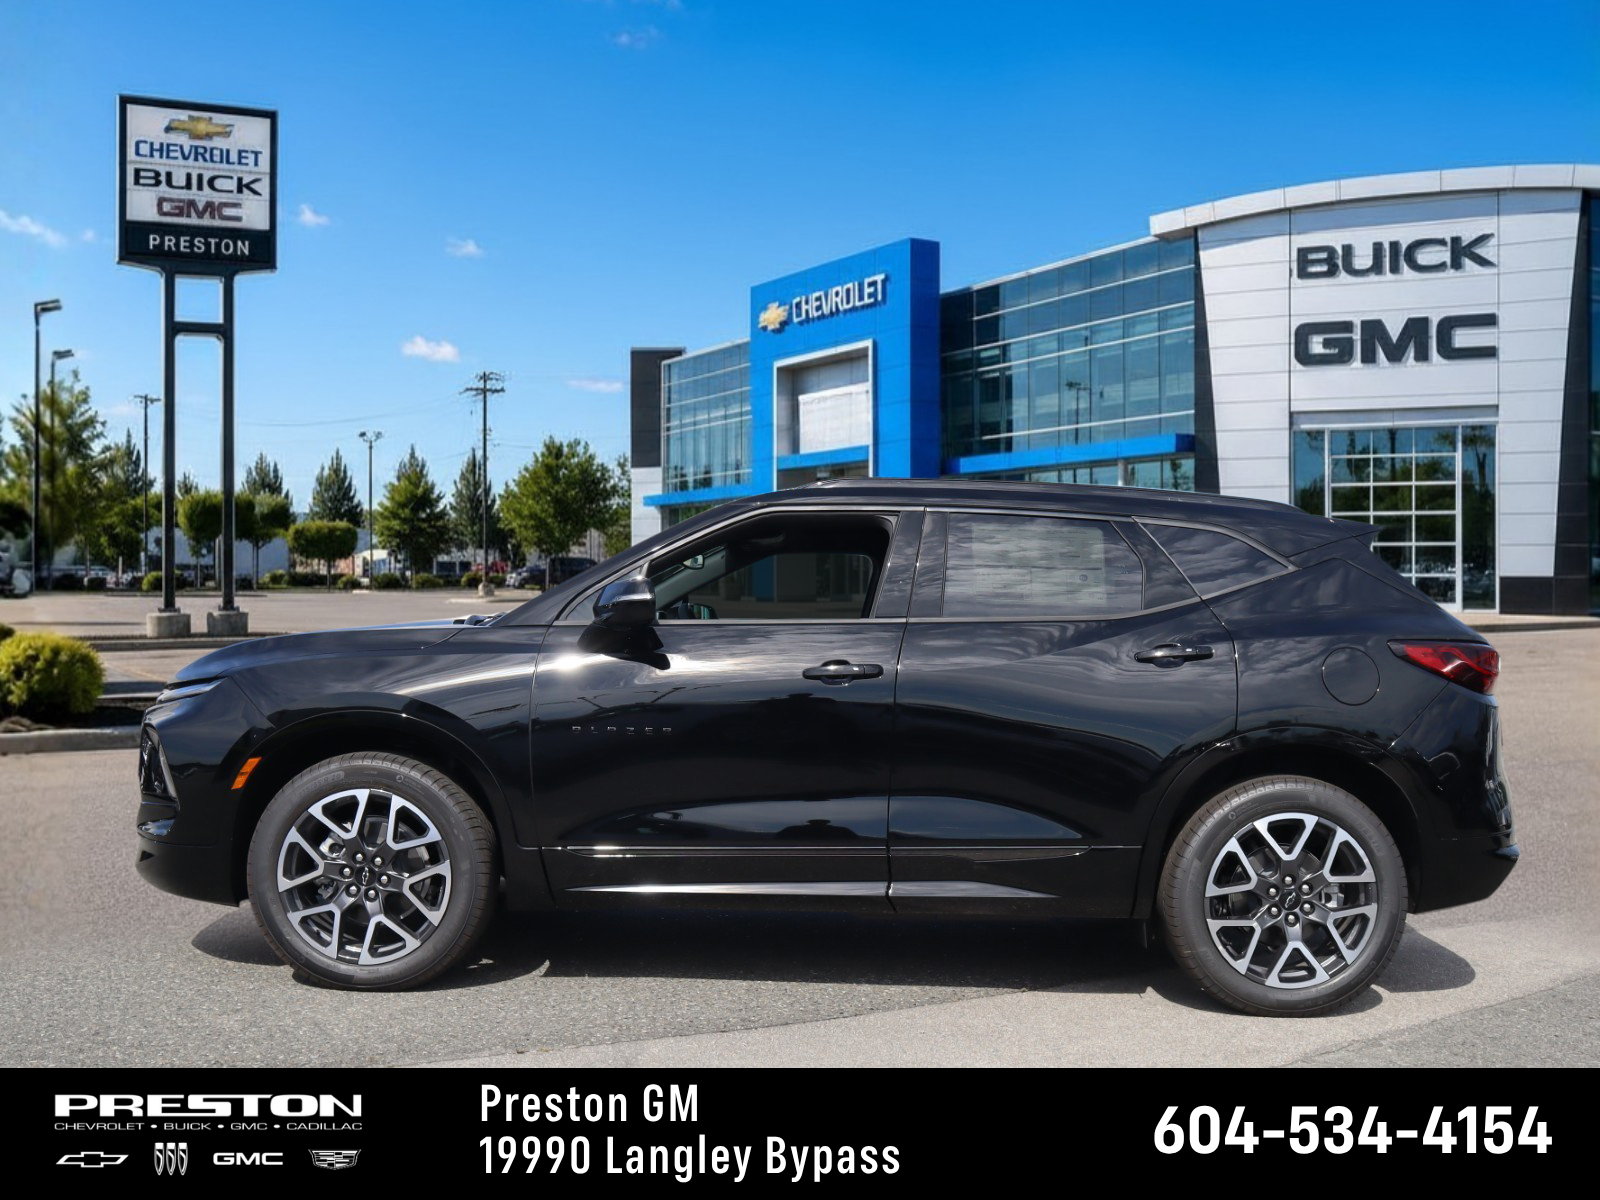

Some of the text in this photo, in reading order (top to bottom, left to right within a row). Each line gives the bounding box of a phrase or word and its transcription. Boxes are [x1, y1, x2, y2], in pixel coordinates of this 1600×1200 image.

[134, 140, 263, 167] CHEVROLET
[133, 167, 262, 196] BUICK
[156, 196, 243, 222] GMC
[149, 234, 250, 255] PRESTON
[1297, 233, 1498, 280] BUICK
[792, 273, 886, 323] CHEVROLET
[1294, 312, 1497, 366] GMC
